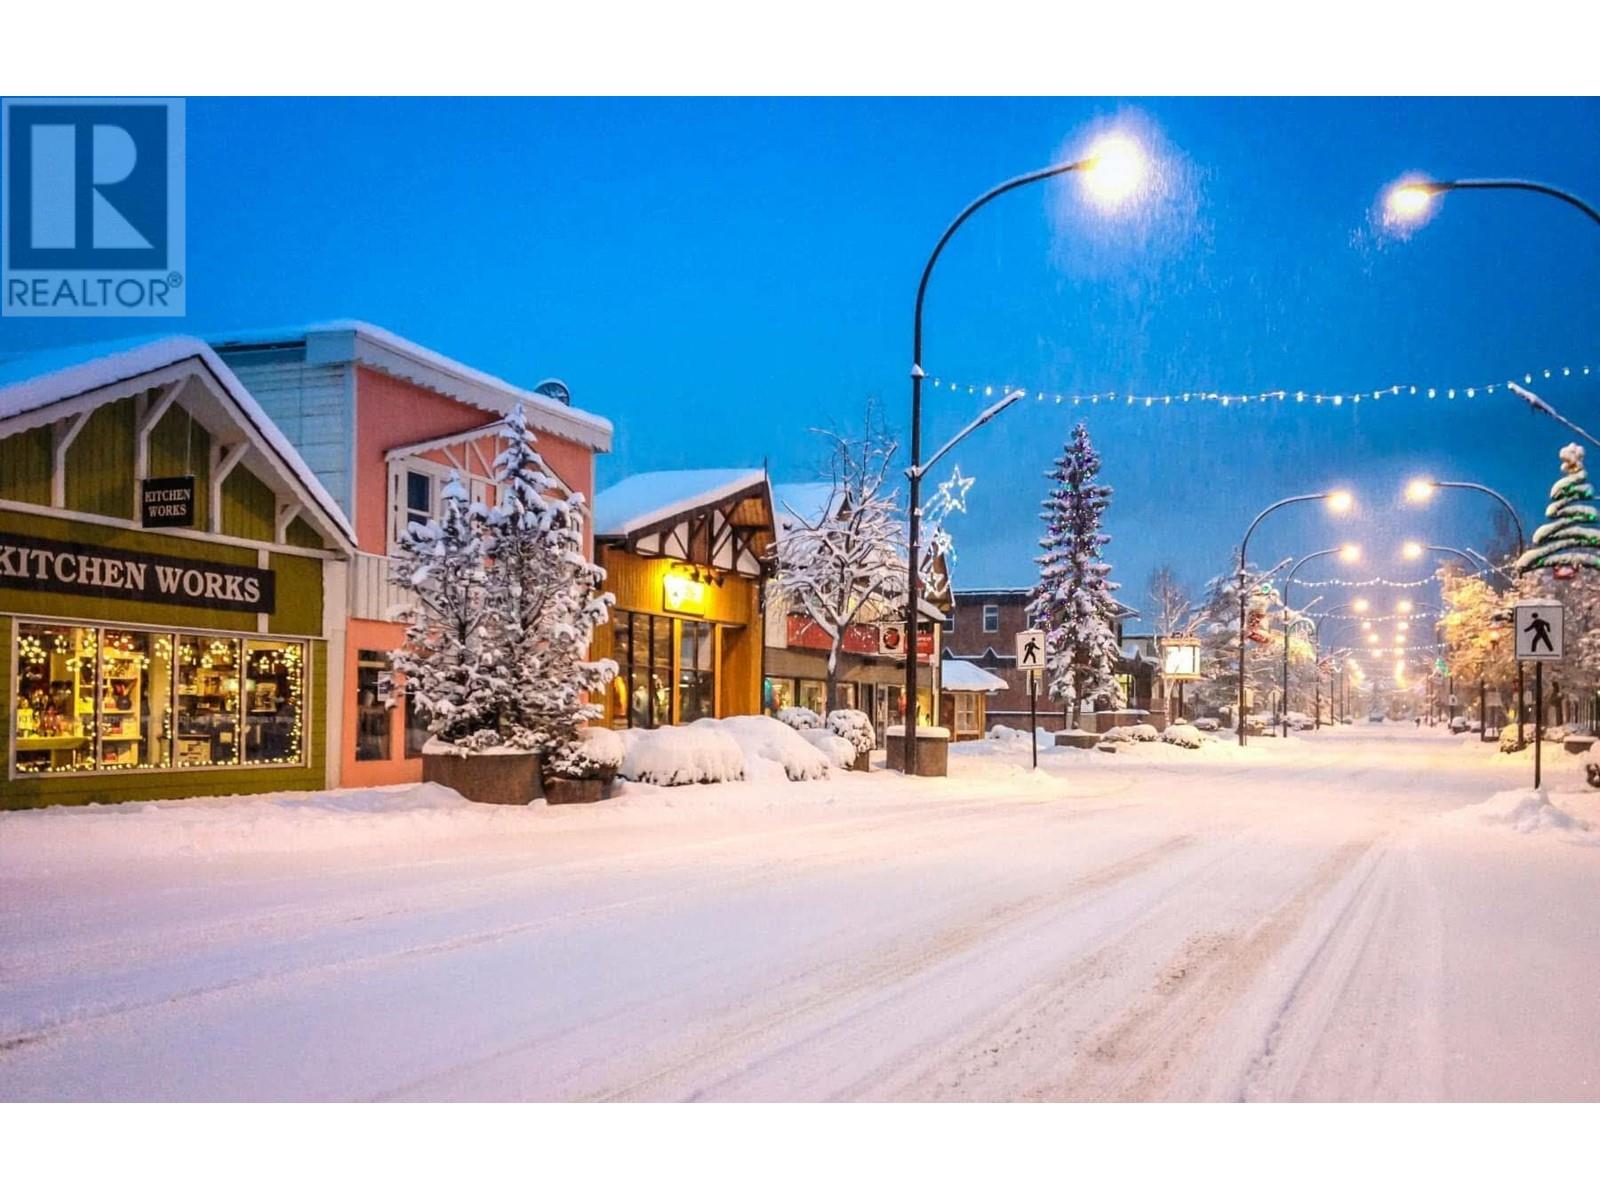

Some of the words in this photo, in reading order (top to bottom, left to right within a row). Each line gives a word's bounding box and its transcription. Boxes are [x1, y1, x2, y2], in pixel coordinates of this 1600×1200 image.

[145, 488, 191, 502] KITCHEN
[148, 504, 187, 517] WORKS
[0, 545, 147, 590] KITCHEN
[155, 565, 261, 602] WORKS
